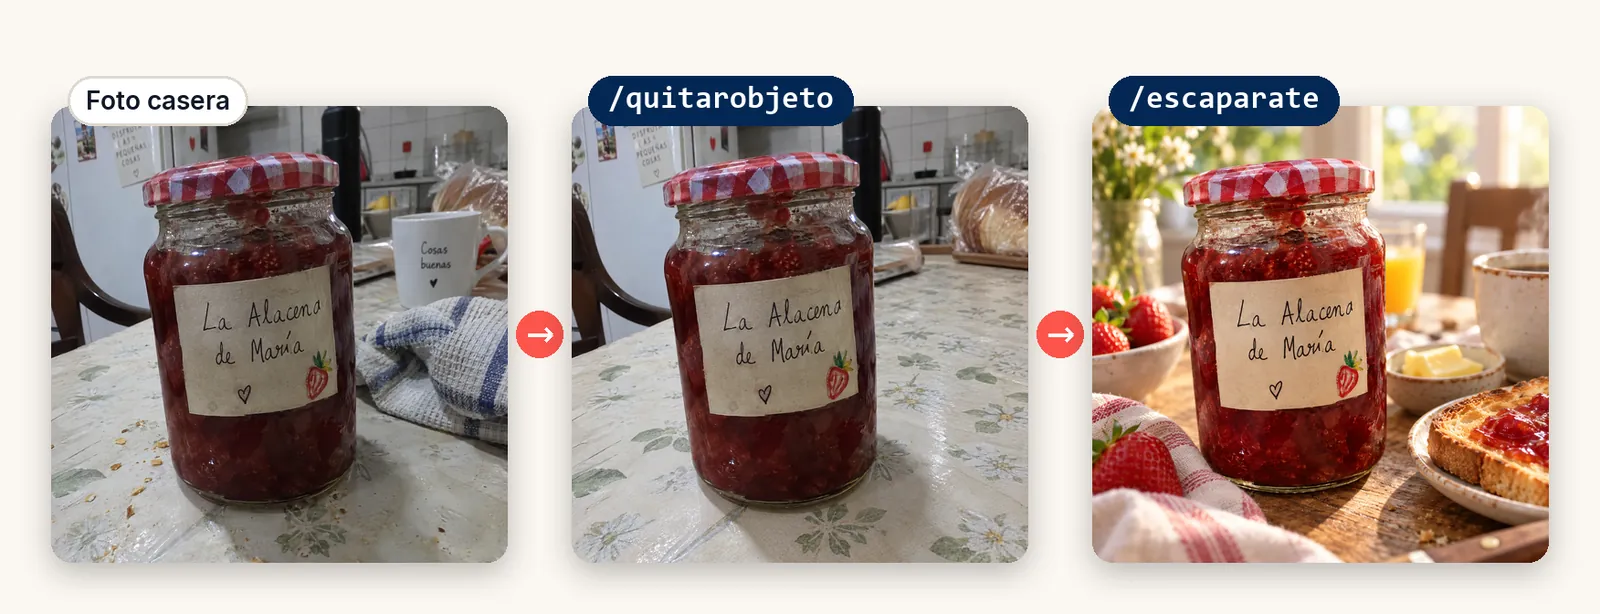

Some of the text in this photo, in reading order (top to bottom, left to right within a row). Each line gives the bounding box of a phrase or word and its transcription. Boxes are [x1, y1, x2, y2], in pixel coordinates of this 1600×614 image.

[420, 241, 448, 255] Cosas
[420, 256, 452, 269] buenas
[203, 299, 321, 331] La Alacena
[723, 299, 842, 331] La Alacena
[1237, 298, 1354, 327] La Alacena
[215, 331, 305, 365] de María
[735, 331, 826, 365] de María
[1248, 330, 1336, 361] de María
